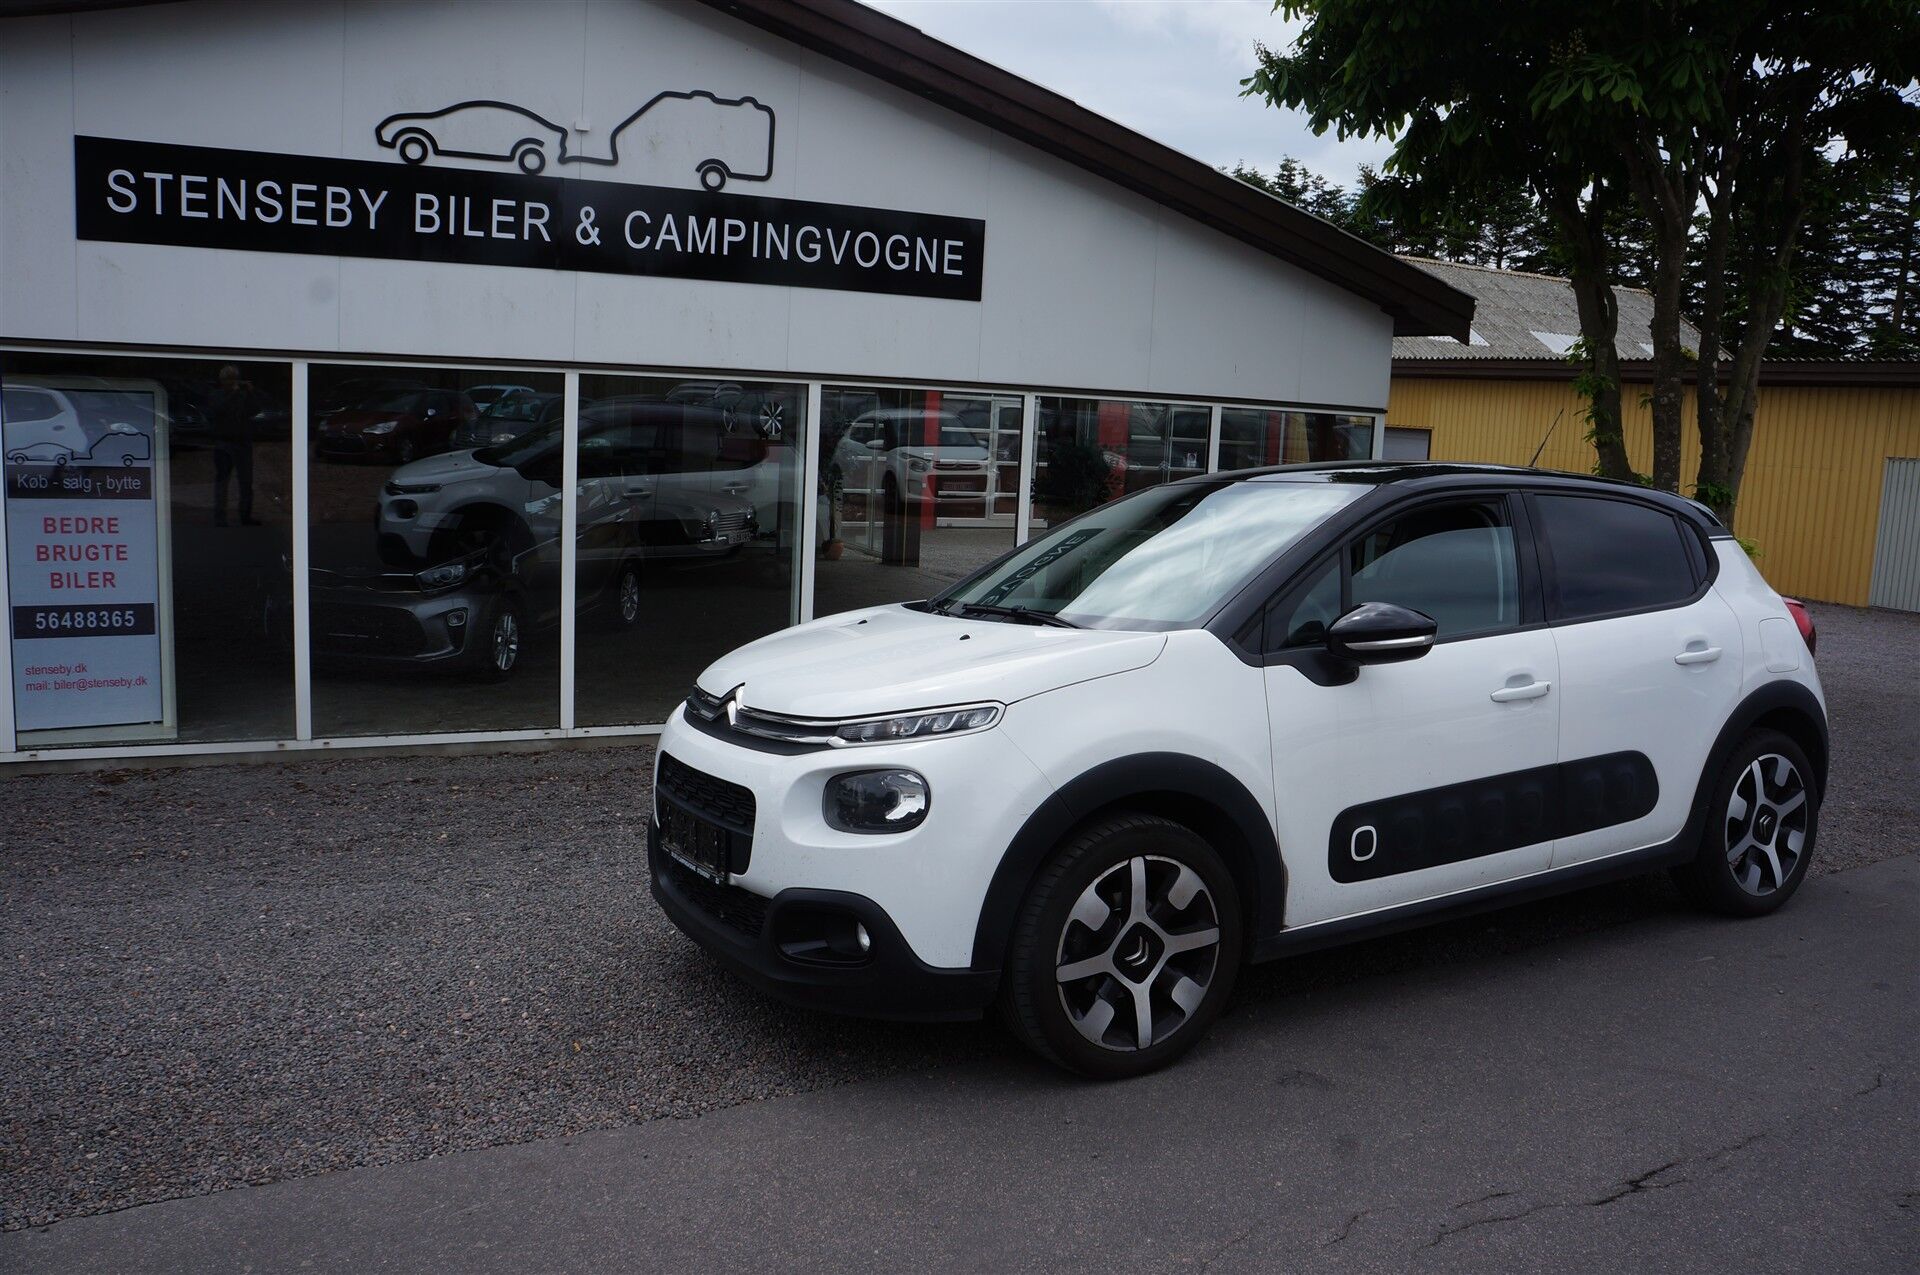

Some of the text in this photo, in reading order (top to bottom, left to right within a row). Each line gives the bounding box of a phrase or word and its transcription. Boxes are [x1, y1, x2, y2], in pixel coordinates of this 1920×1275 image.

[106, 169, 964, 276] STENSEBY BILER & CAMPINGVOGNE
[17, 474, 49, 489] Køb
[63, 475, 92, 493] salg
[106, 475, 142, 493] bytte
[43, 517, 119, 534] BEDRE
[36, 544, 128, 562] BRUGTE
[50, 572, 117, 589] BILER
[36, 610, 135, 630] 56488365
[25, 663, 87, 677] stenseby.dk
[25, 676, 147, 691] mail: biler@stenseby.dk
